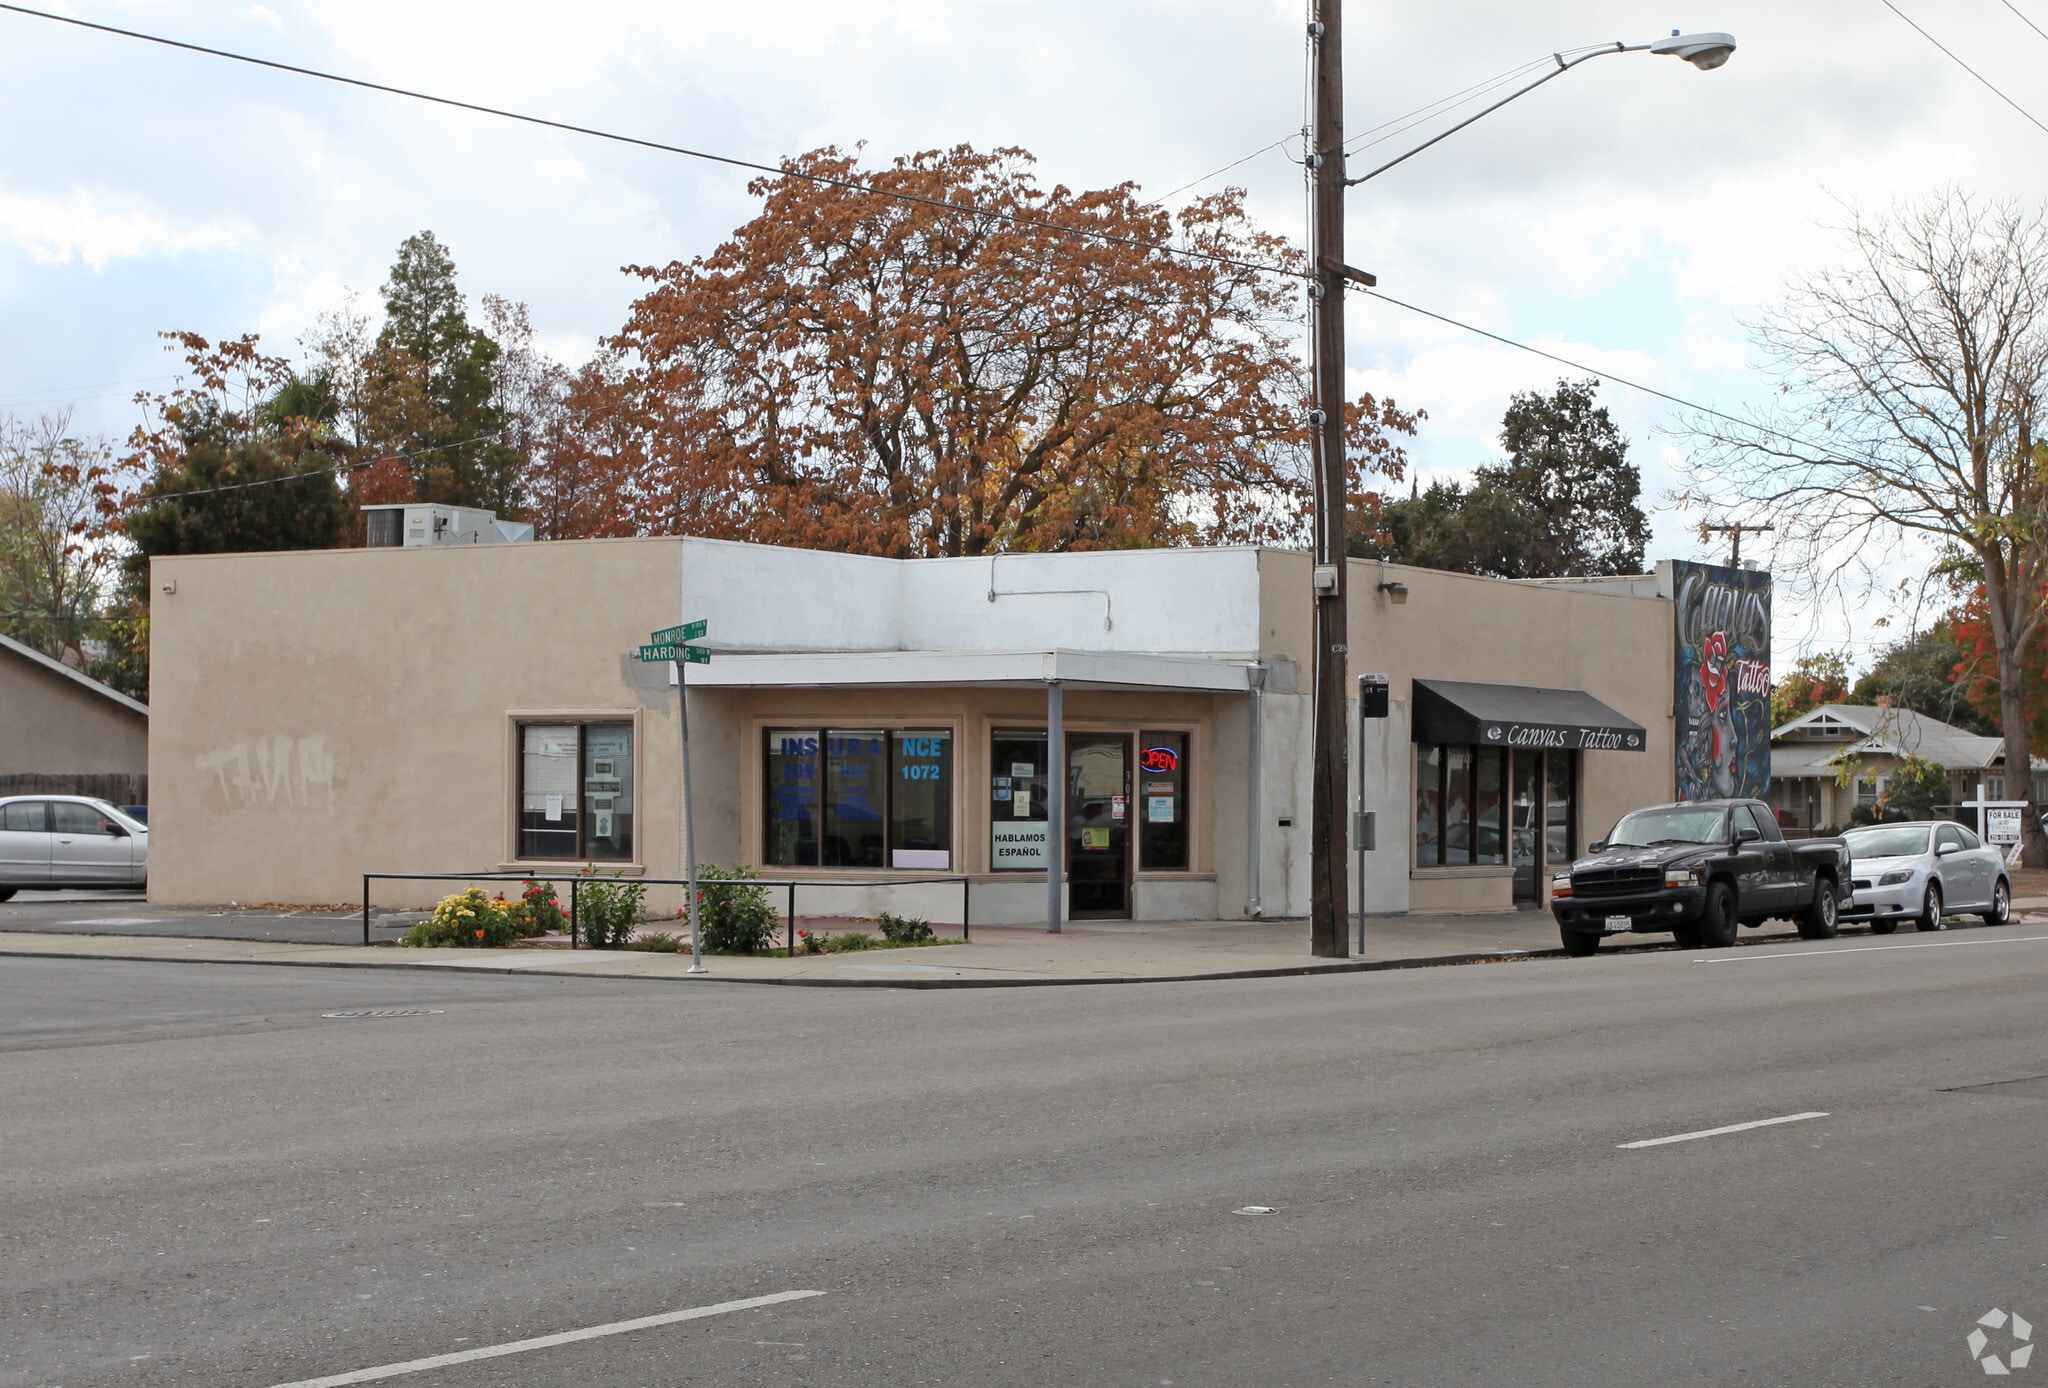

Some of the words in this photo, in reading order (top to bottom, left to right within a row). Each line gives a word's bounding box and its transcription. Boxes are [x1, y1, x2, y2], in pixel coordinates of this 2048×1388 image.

[1676, 568, 1770, 653] Canvas
[652, 627, 687, 646] MONROE
[643, 646, 690, 660] HARDING
[1735, 660, 1770, 697] Tattoo
[1507, 725, 1568, 747] Canvas
[1577, 727, 1622, 750] Tattoo
[1141, 749, 1177, 771] OPEN
[902, 764, 940, 780] 1072
[1989, 811, 2002, 819] FOR
[2003, 811, 2019, 819] SALE
[995, 834, 1045, 842] HABLAMOS
[999, 847, 1041, 856] ESPAÑOL
